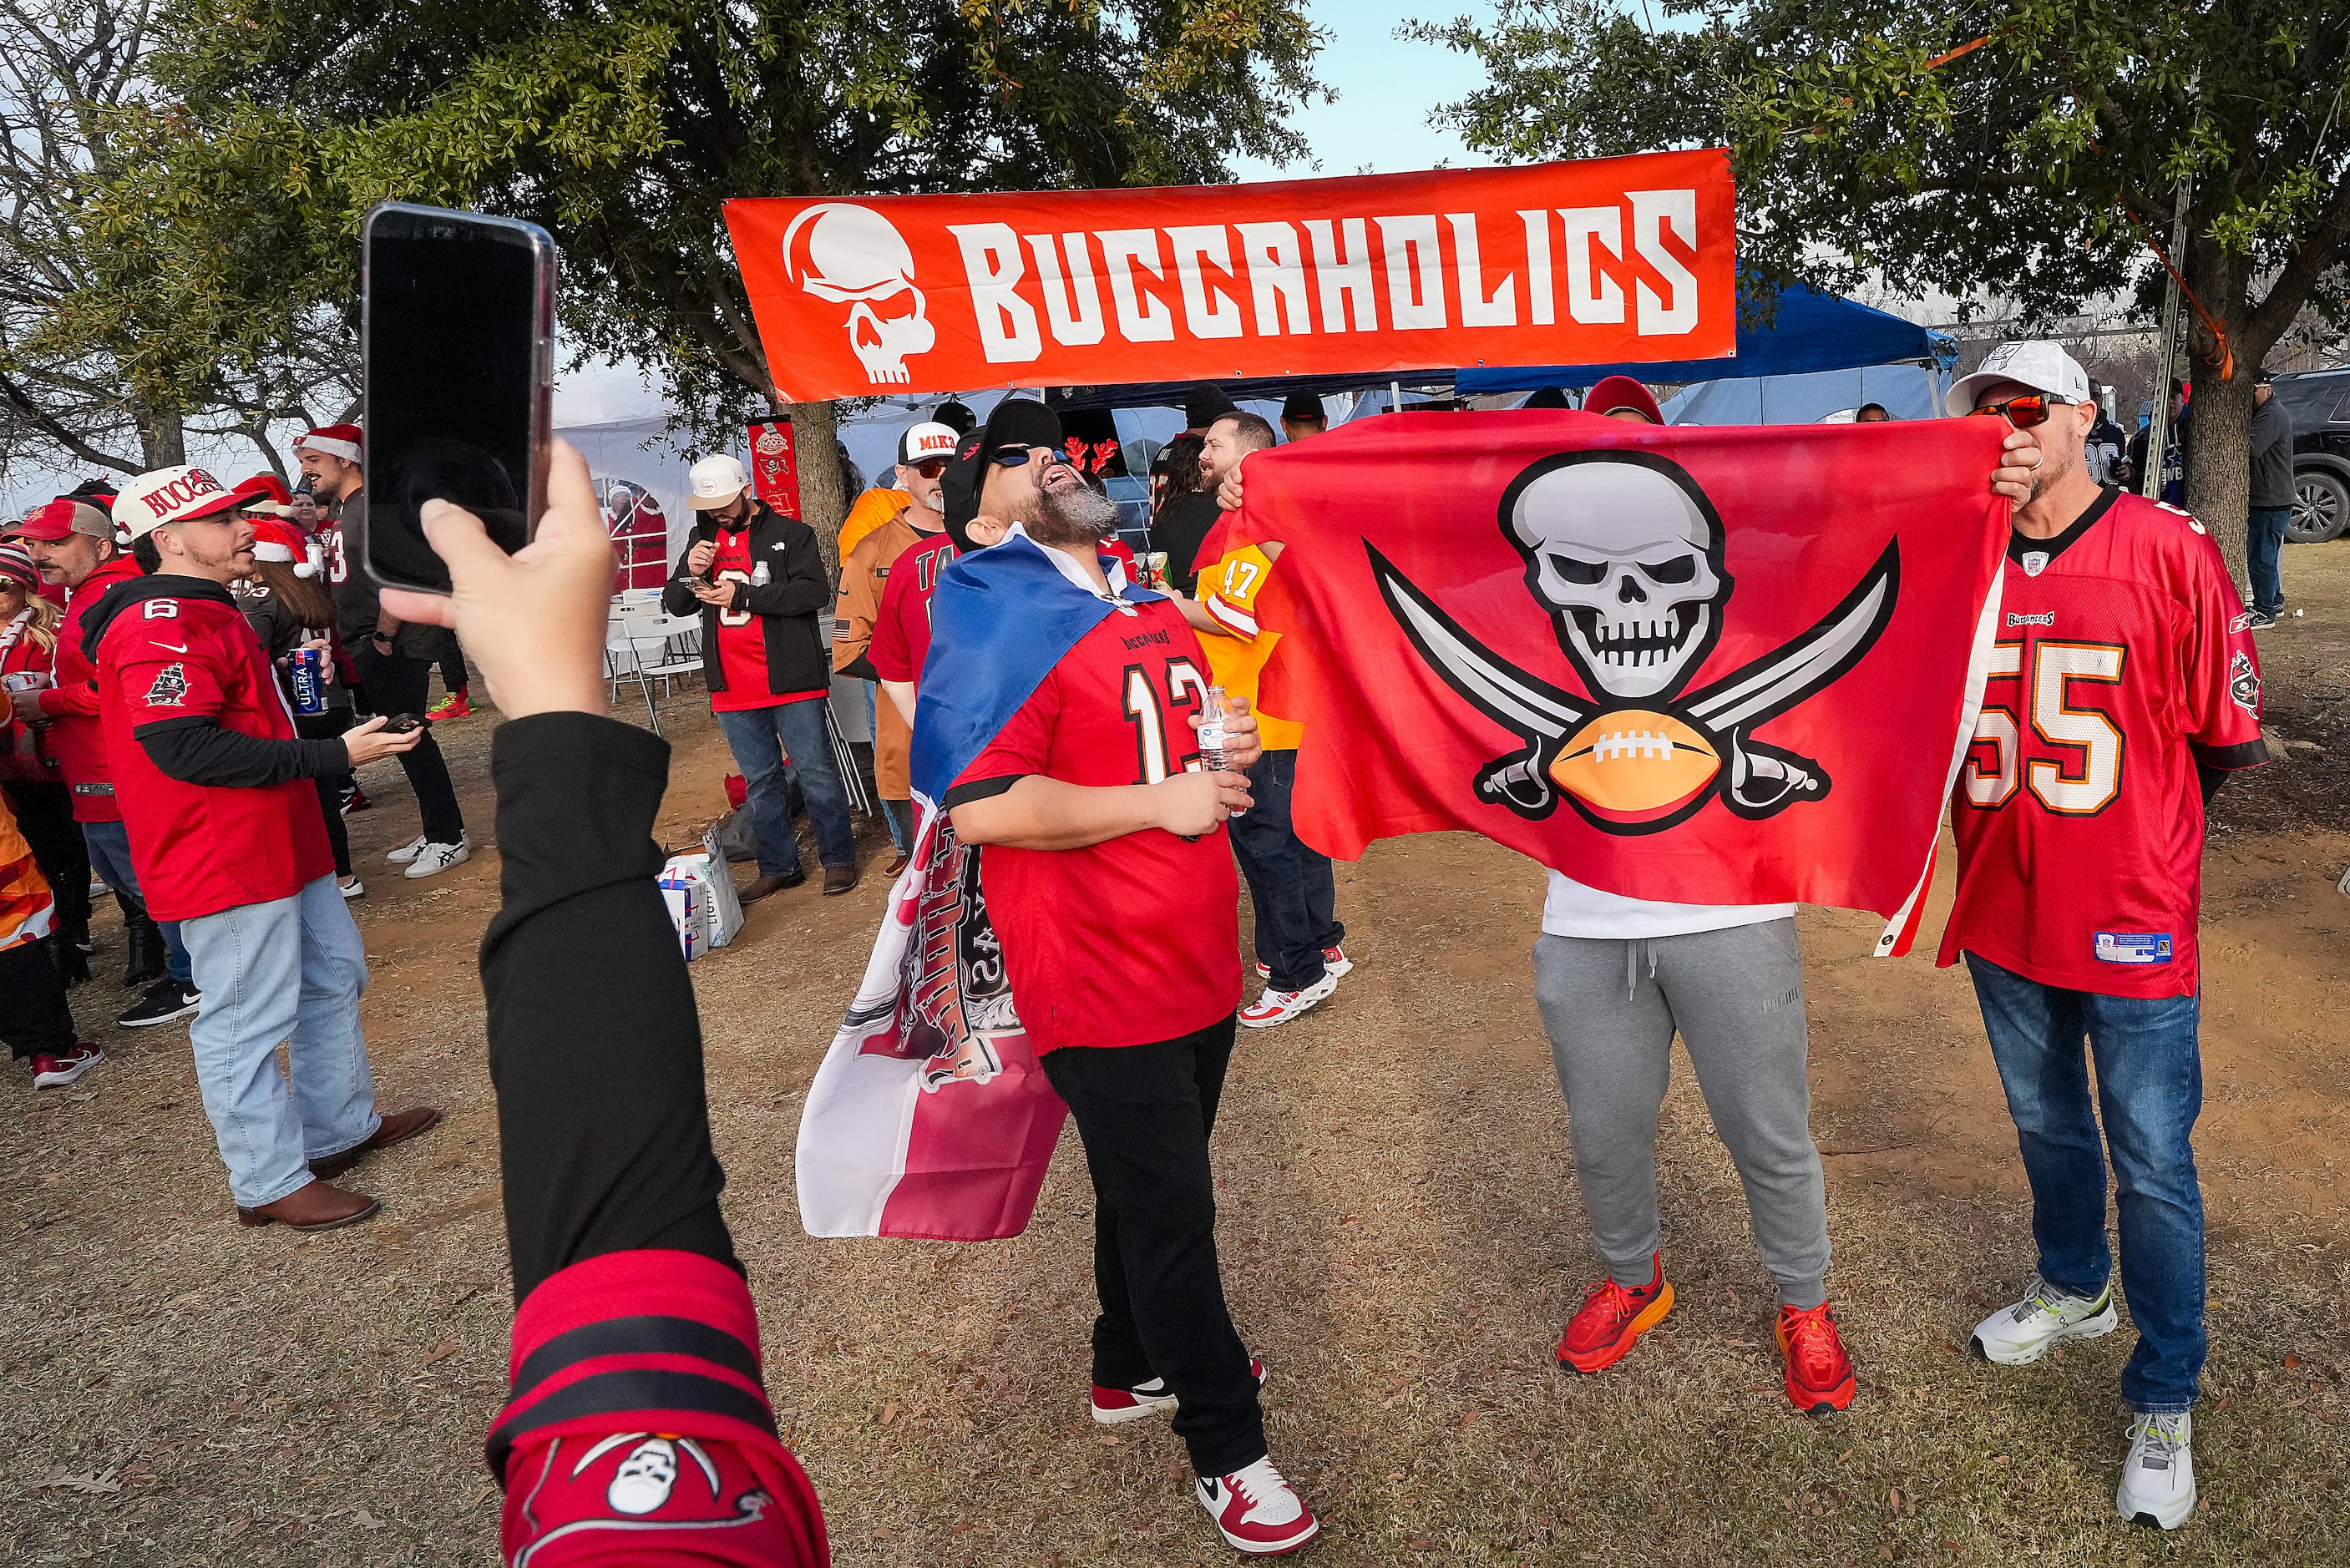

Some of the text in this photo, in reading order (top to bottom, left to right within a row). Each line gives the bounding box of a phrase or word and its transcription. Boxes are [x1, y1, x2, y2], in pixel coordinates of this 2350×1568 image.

[945, 189, 1699, 364] BUCCAHOLICS
[915, 544, 954, 591] TA
[1223, 559, 1259, 600] 47
[142, 597, 181, 621] 6
[296, 667, 311, 706] ULTRA
[1965, 638, 2129, 818] 55
